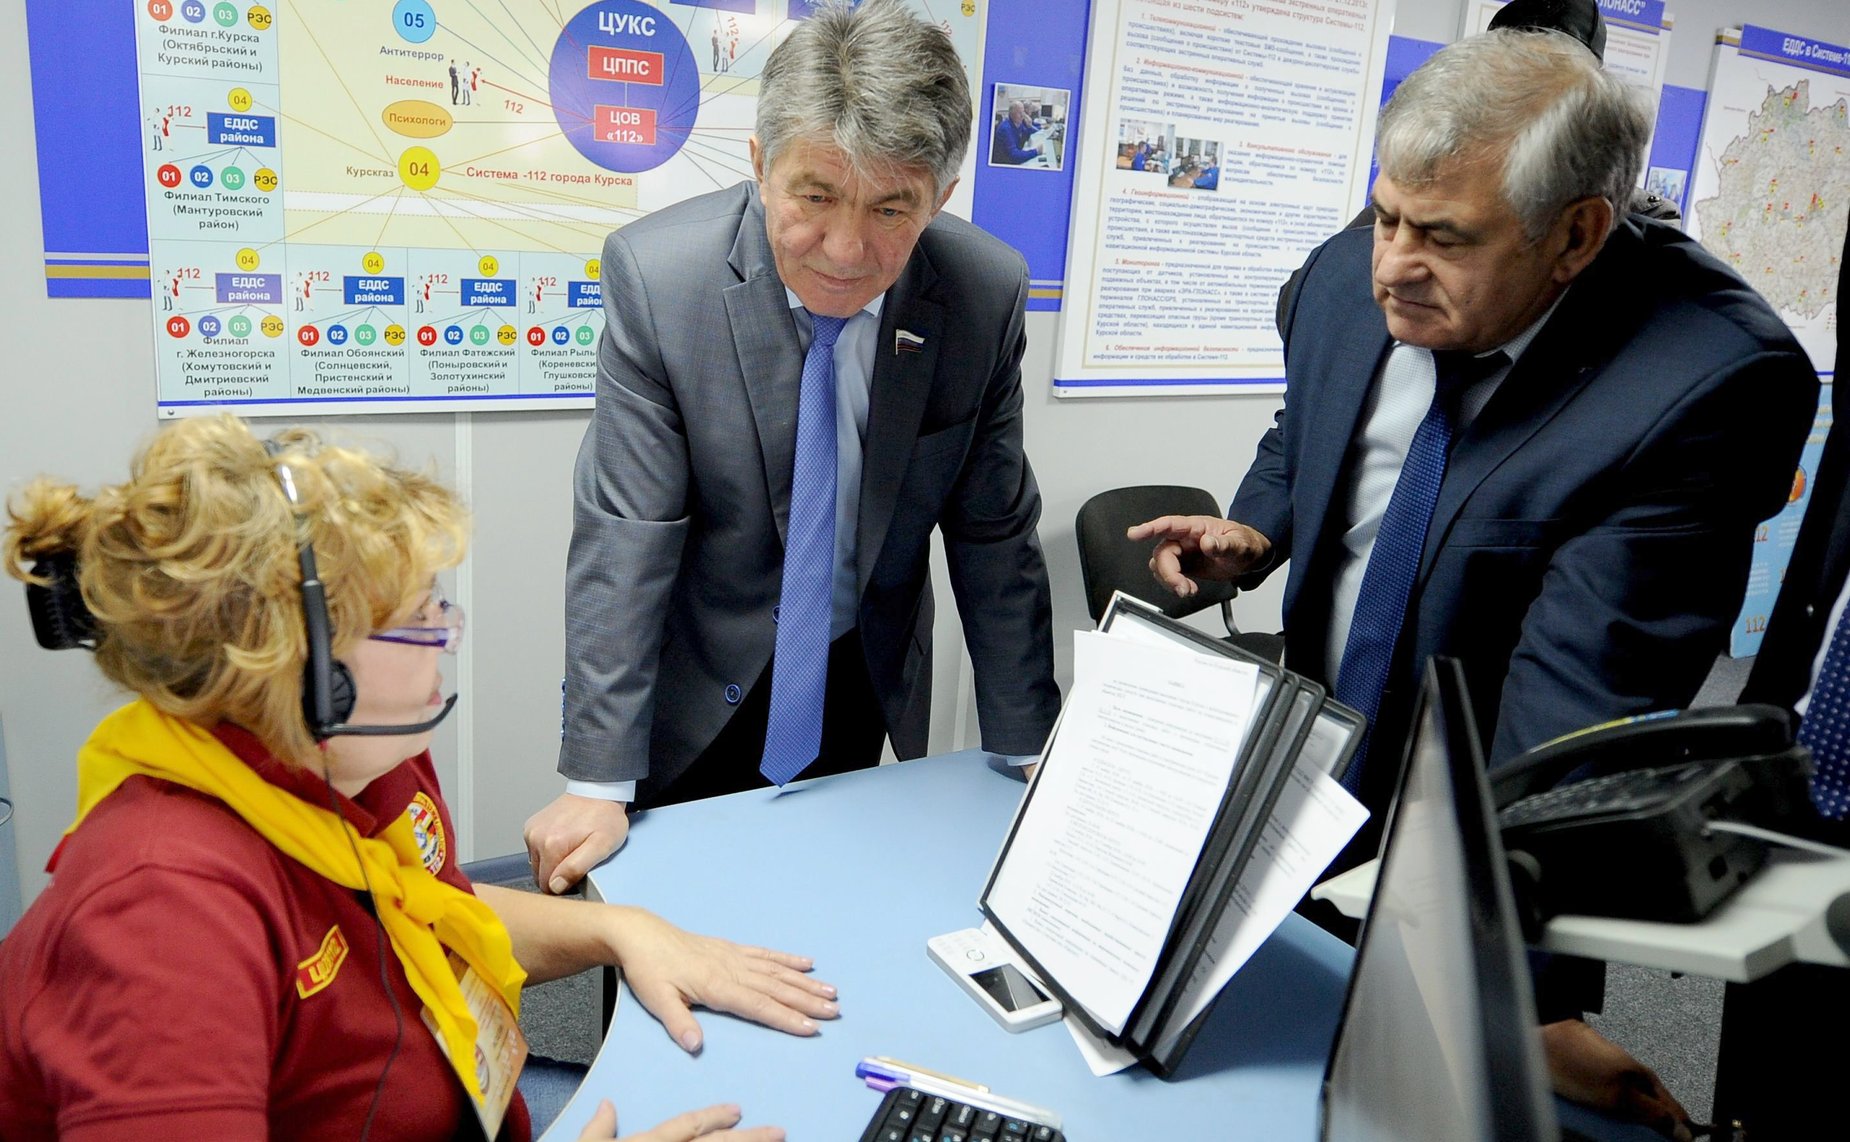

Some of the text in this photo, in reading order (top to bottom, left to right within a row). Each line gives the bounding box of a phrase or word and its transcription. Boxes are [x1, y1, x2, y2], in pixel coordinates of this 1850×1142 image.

[153, 4, 168, 14] 01
[186, 6, 200, 18] 02
[218, 10, 234, 20] 03
[1252, 4, 1290, 17] утверждена
[1292, 12, 1324, 24] структура
[247, 12, 272, 24] РЭС
[403, 13, 425, 29] 05
[598, 10, 656, 37] ЦУКС
[158, 24, 260, 44] Филиал г.Курска
[162, 38, 257, 58] (Октябрьский и
[1782, 38, 1806, 56] ЕДДС
[1805, 46, 1812, 56] в
[380, 45, 444, 62] Антитеррор
[158, 52, 263, 74] Курский районы)
[602, 56, 650, 76] ЦППС
[385, 74, 444, 90] Население
[233, 95, 248, 106] 04
[503, 99, 524, 114] 112
[167, 105, 192, 118] 112
[224, 118, 259, 131] ЕДДС
[388, 112, 446, 128] Психологи
[610, 112, 640, 128] ЦОВ
[220, 132, 264, 146] района
[606, 129, 644, 144] «112»
[162, 170, 176, 182] 01
[346, 166, 394, 178] Курскгаз
[408, 162, 430, 178] 04
[194, 171, 208, 182] 02
[226, 174, 240, 184] 03
[254, 175, 278, 186] РЭС
[466, 166, 632, 187] Система -112 города Курска
[164, 190, 270, 206] Филиал Тимского
[172, 204, 264, 218] (Мантуровский
[198, 218, 240, 232] район)
[240, 255, 254, 265] 04
[367, 258, 380, 268] 04
[176, 268, 200, 280] 112
[308, 270, 330, 282] 112
[428, 274, 448, 284] 112
[232, 277, 266, 289] ЕДДС
[358, 279, 390, 291] ЕДДС
[538, 276, 556, 287] 112
[474, 282, 503, 294] ЕДДС
[580, 284, 600, 295] ЕДД
[228, 290, 271, 302] района
[354, 292, 394, 304] района
[470, 294, 507, 306] района
[576, 296, 602, 306] райо
[171, 322, 185, 332] 01
[202, 321, 216, 332] 02
[233, 321, 247, 332] 03
[260, 322, 284, 332] РЭС
[202, 336, 249, 346] Филиал
[302, 331, 315, 341] 01
[331, 330, 344, 340] 02
[359, 330, 372, 340] 03
[384, 330, 406, 340] РЭС
[420, 331, 433, 341] 01
[447, 330, 460, 340] 02
[474, 331, 486, 340] 03
[497, 330, 518, 340] РЭС
[530, 332, 542, 342] 01
[555, 332, 567, 341] 02
[579, 332, 590, 341] 03
[186, 349, 275, 360] Железногорска
[300, 347, 405, 358] Филиал Обоянский
[420, 348, 516, 358] Филиал Фатежский
[182, 361, 262, 373] (Хомутовский
[314, 360, 392, 372] (Солнцевский,
[428, 360, 500, 370] (Поныровский
[538, 360, 596, 369] (Кореневски
[184, 373, 270, 386] Дмитриевский
[314, 372, 384, 383] Пристенский
[430, 372, 506, 382] Золотухинский
[543, 371, 596, 380] Глушковск
[204, 386, 253, 398] районы)
[297, 384, 410, 396] Медвенский районы)
[447, 384, 490, 394] районы)
[554, 382, 593, 392] районы)
[1754, 526, 1769, 542] 12
[1745, 616, 1766, 634] 112
